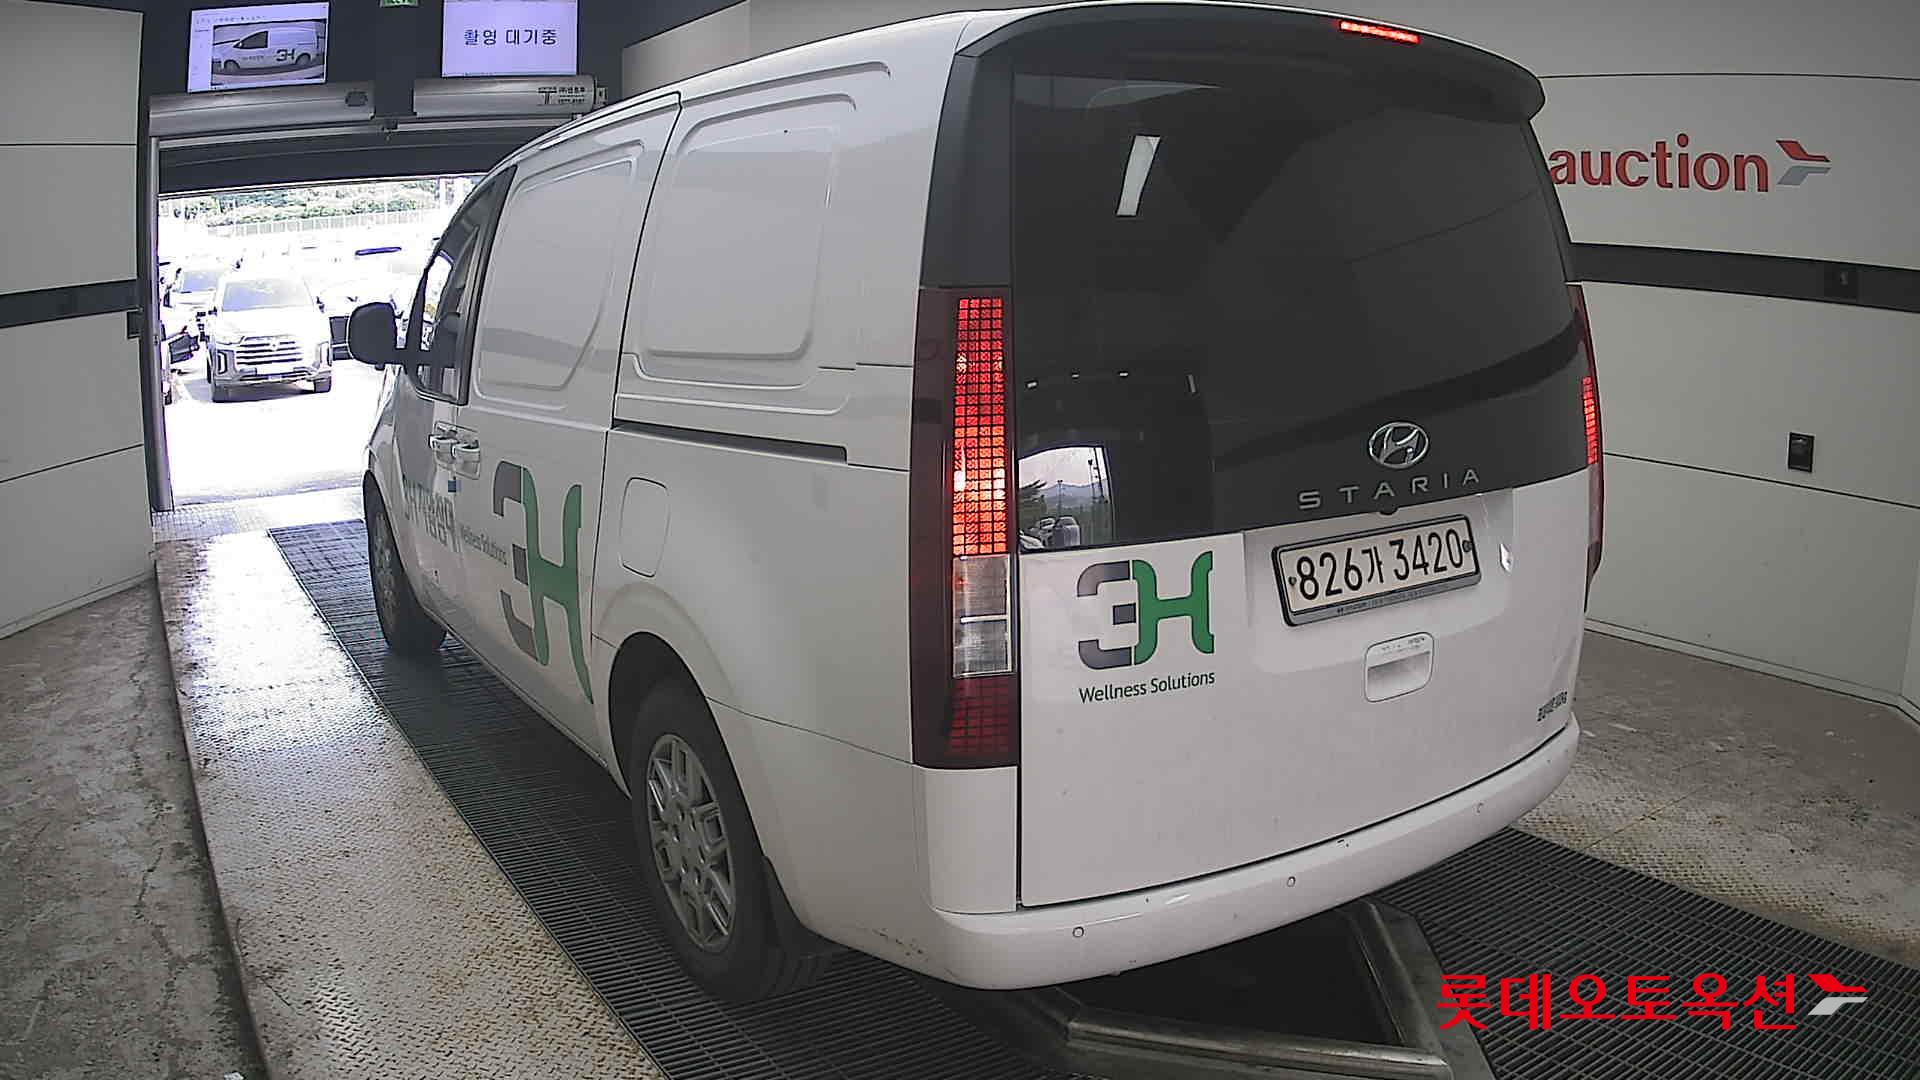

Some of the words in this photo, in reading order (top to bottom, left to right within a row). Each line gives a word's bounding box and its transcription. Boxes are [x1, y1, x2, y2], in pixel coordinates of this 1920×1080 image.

[464, 29, 497, 46] 촬영
[505, 29, 557, 46] 대기중
[1549, 133, 1769, 192] auction
[1298, 469, 1480, 510] STARIA
[1295, 545, 1385, 601] 826가
[1389, 528, 1464, 582] 3420
[1077, 550, 1215, 670] 3H
[1079, 682, 1147, 704] Wellness
[1150, 672, 1216, 693] Solutions
